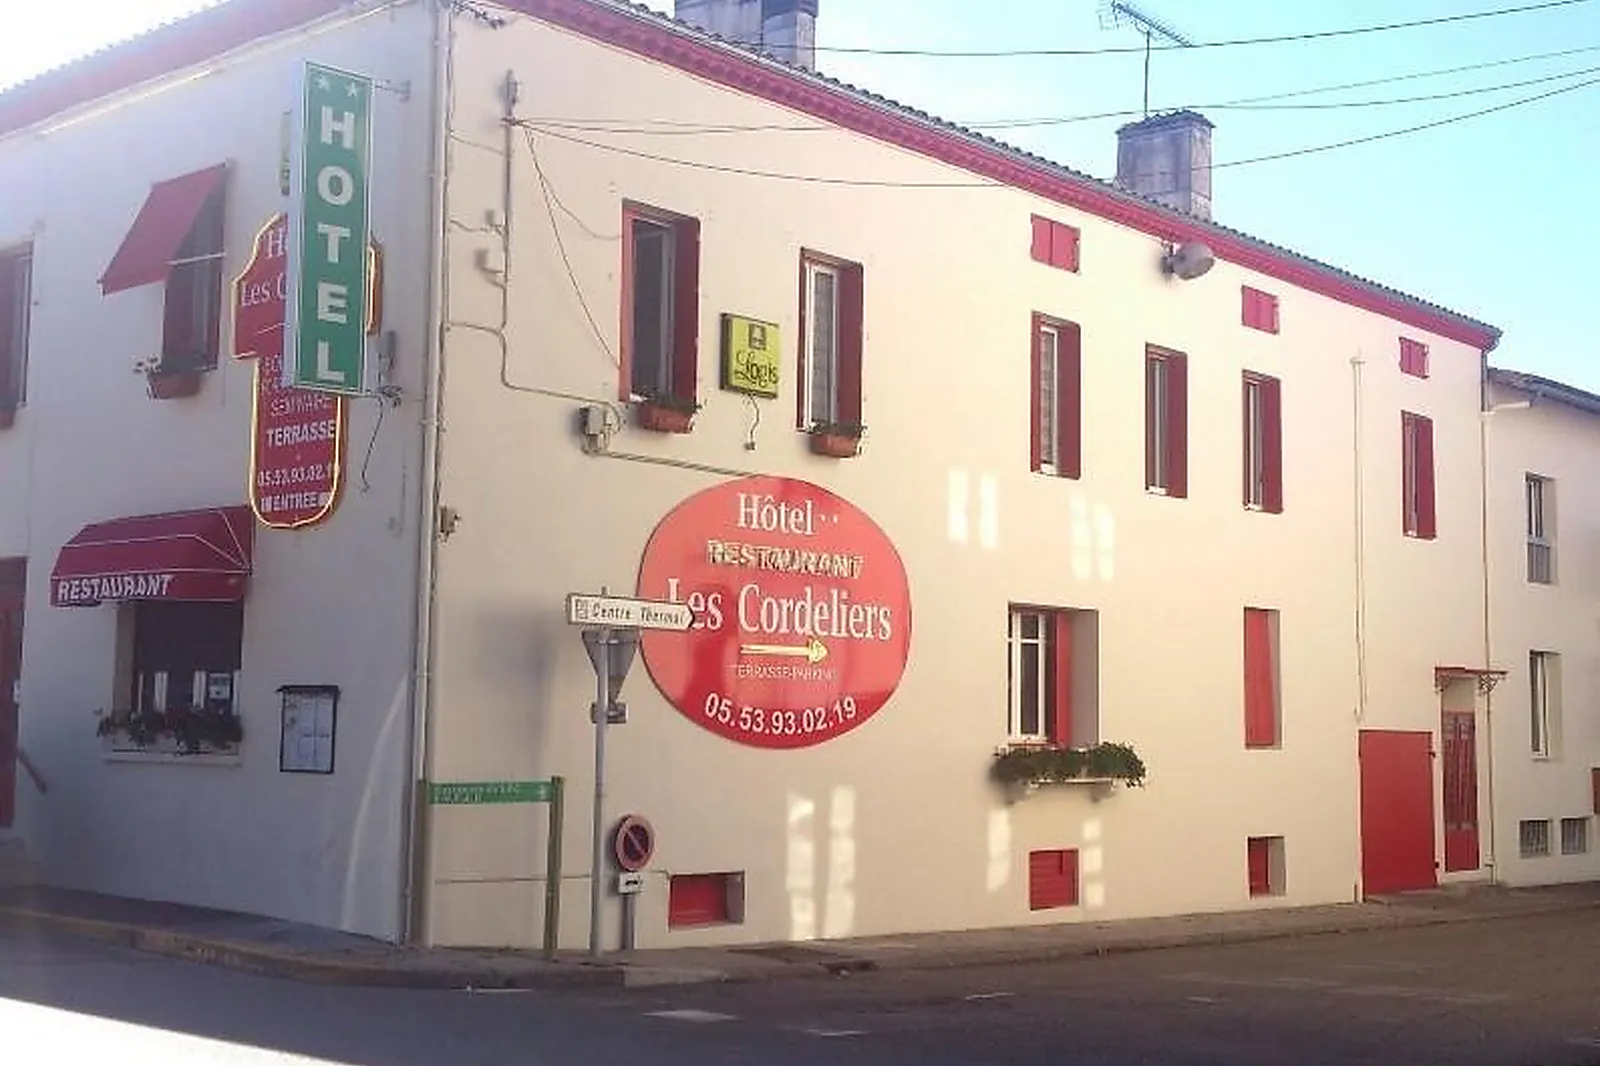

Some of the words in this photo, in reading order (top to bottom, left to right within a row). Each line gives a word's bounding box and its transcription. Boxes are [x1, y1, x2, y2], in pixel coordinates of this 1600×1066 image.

[316, 105, 355, 382] HOTEL
[240, 280, 271, 306] Les
[735, 351, 778, 388] Logis
[266, 420, 336, 447] TERRASSE
[257, 461, 333, 486] 05.53.93.02.1
[737, 492, 814, 535] Hôtel
[708, 540, 864, 579] RESTAURANT
[58, 575, 174, 601] RESTAURANT
[738, 584, 892, 640] Cordeliers
[705, 693, 857, 734] 05.53.93.02.19
